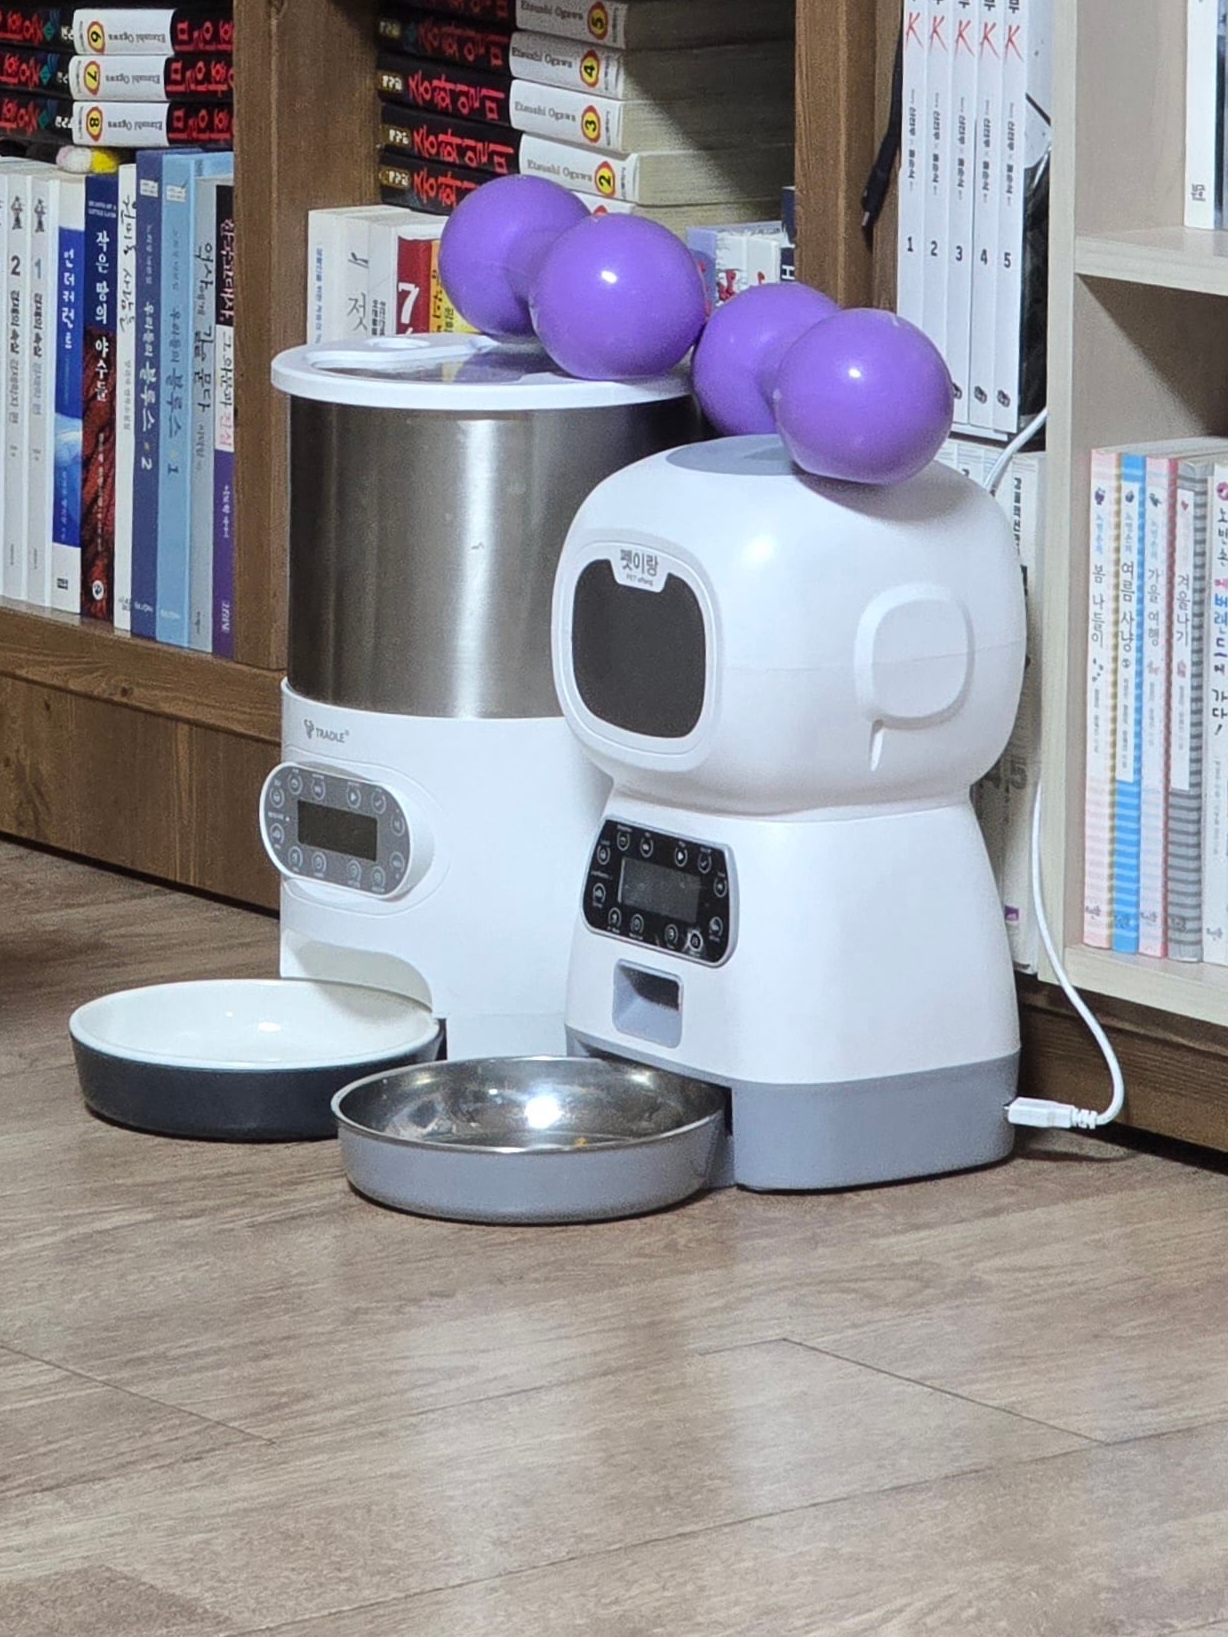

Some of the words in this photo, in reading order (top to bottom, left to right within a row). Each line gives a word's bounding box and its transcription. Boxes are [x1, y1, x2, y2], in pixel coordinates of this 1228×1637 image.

[520, 0, 553, 18] Etsushi
[555, 5, 584, 24] Ogawa
[591, 11, 605, 30] 5
[90, 27, 102, 43] 6
[904, 11, 924, 50] K
[928, 14, 948, 52] K
[953, 19, 975, 59] K
[978, 22, 1000, 61] K
[1003, 24, 1024, 63] K
[512, 46, 539, 63] Etsushi
[540, 51, 573, 69] Ogawa
[583, 60, 597, 77] 4
[86, 70, 98, 85] 7
[408, 69, 505, 121] 중화일미
[88, 115, 101, 131] 8
[514, 101, 547, 119] Etsushi
[547, 107, 577, 124] Ogawa
[585, 119, 599, 133] 3
[413, 124, 514, 174] 중화일미
[527, 158, 560, 176] Etsushi
[560, 165, 593, 183] Ogawa
[598, 171, 612, 188] 2
[121, 195, 136, 255] 원미동
[95, 230, 110, 274] 작은
[907, 236, 914, 253] 1
[930, 240, 938, 257] 2
[955, 245, 963, 262] 3
[980, 249, 988, 265] 4
[1003, 252, 1011, 269] 5
[11, 256, 21, 277] 2
[35, 259, 42, 280] 1
[10, 290, 21, 326] 경제의
[33, 293, 43, 330] 경제의
[95, 281, 109, 325] 땅의
[119, 269, 135, 333] 사람들
[10, 327, 21, 354] 속살
[33, 331, 43, 358] 속살
[142, 300, 155, 357] 우리들의
[168, 309, 181, 365] 우리들의
[193, 324, 214, 360] 길을
[94, 336, 109, 402] 야수들
[220, 353, 233, 407] 의문과
[139, 360, 157, 433] 블루스
[165, 367, 184, 439] 블루스
[193, 370, 212, 414] 묻다
[220, 412, 233, 448] 진실
[141, 456, 152, 471] 2
[168, 464, 179, 475] 1
[619, 547, 659, 577] 펫이랑
[1093, 564, 1106, 584] 봄
[1121, 561, 1134, 602] 여름
[1148, 568, 1161, 604] 가을
[1091, 593, 1106, 648] 나들이
[1176, 573, 1191, 646] 겨울나기
[1120, 610, 1135, 654] 사냥
[1148, 611, 1160, 647] 여행
[315, 729, 346, 745] TRADLE
